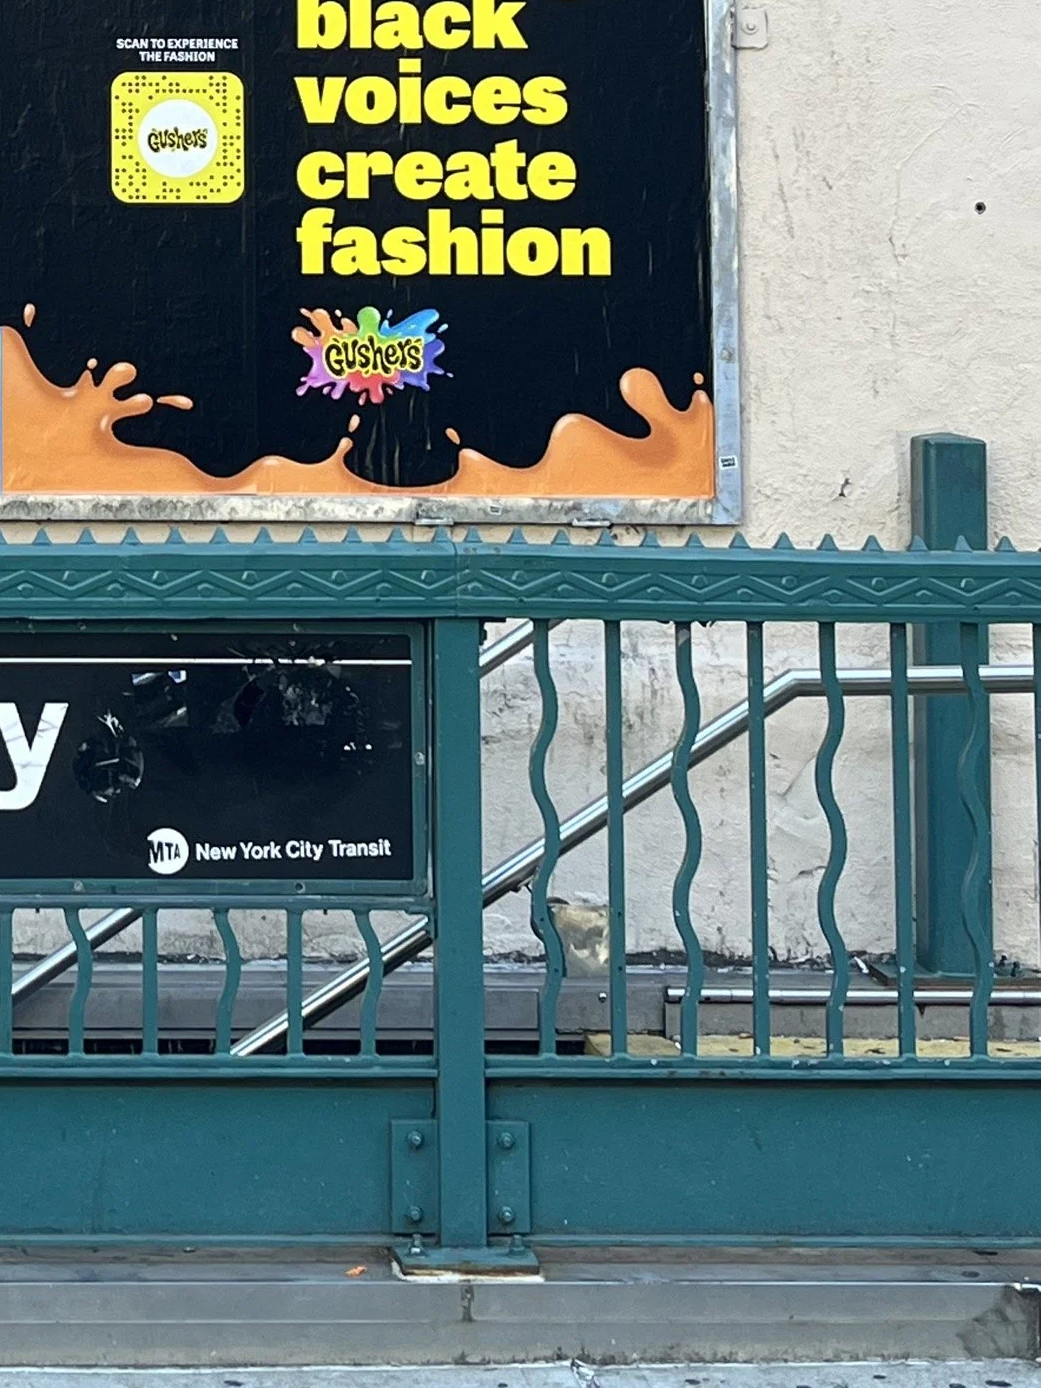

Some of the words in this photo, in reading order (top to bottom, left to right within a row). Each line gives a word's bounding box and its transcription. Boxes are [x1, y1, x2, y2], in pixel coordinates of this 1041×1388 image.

[116, 38, 149, 49] SCAN
[150, 38, 165, 49] TO
[167, 38, 239, 49] EXPERIENCE
[139, 51, 163, 62] THE
[164, 51, 216, 62] FASHION
[294, 58, 568, 125] voices
[296, 139, 577, 200] create
[296, 207, 612, 276] fashion
[149, 840, 181, 864] MTA
[195, 843, 237, 861] New
[240, 841, 282, 860] York
[286, 840, 324, 861] City
[328, 838, 392, 857] Transit
